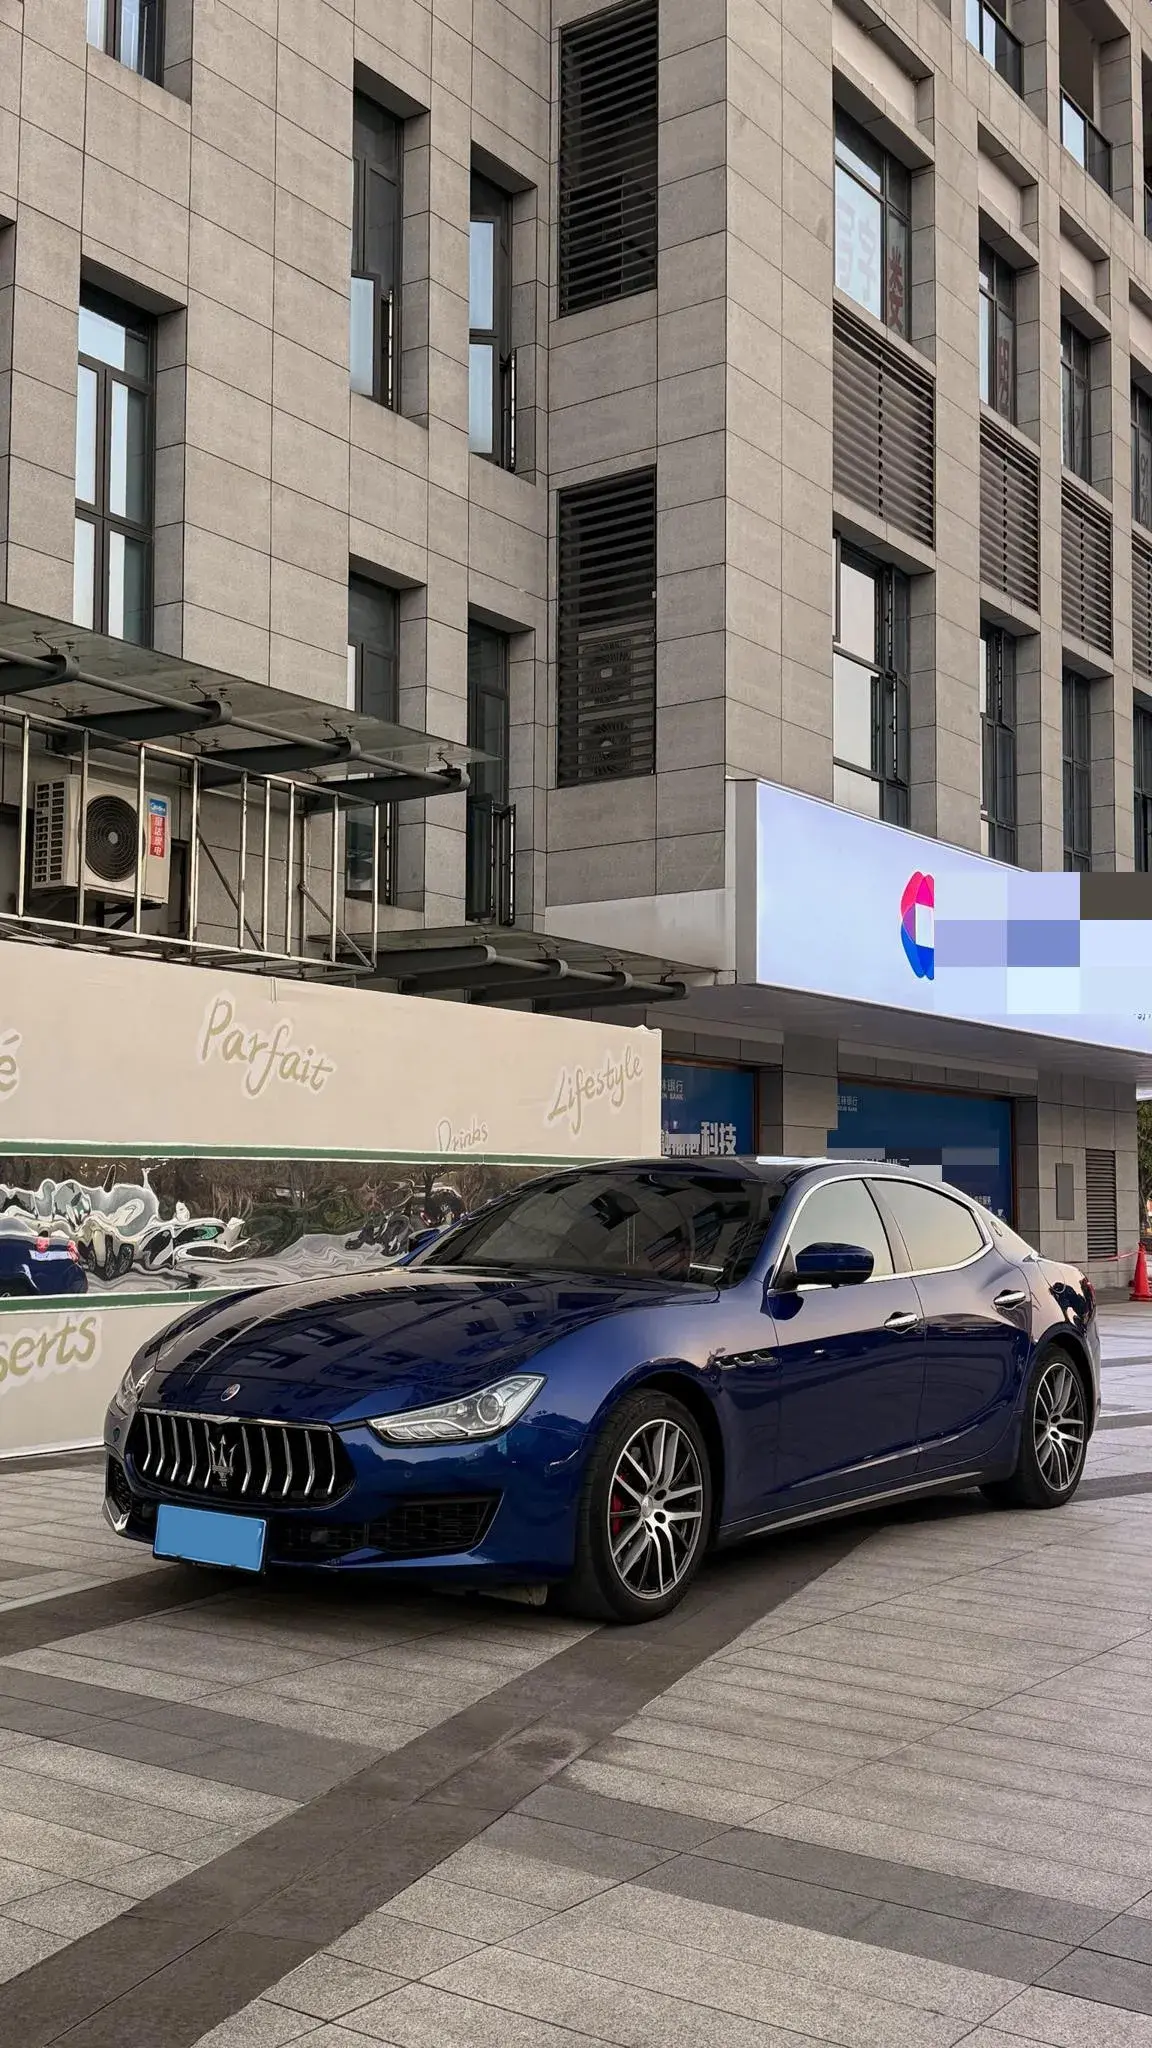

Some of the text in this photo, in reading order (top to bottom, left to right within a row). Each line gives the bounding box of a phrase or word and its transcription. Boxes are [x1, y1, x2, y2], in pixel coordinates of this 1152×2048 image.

[201, 998, 334, 1096] Parfait
[547, 1046, 643, 1135] Lifestyle
[438, 1117, 488, 1152] Drinks
